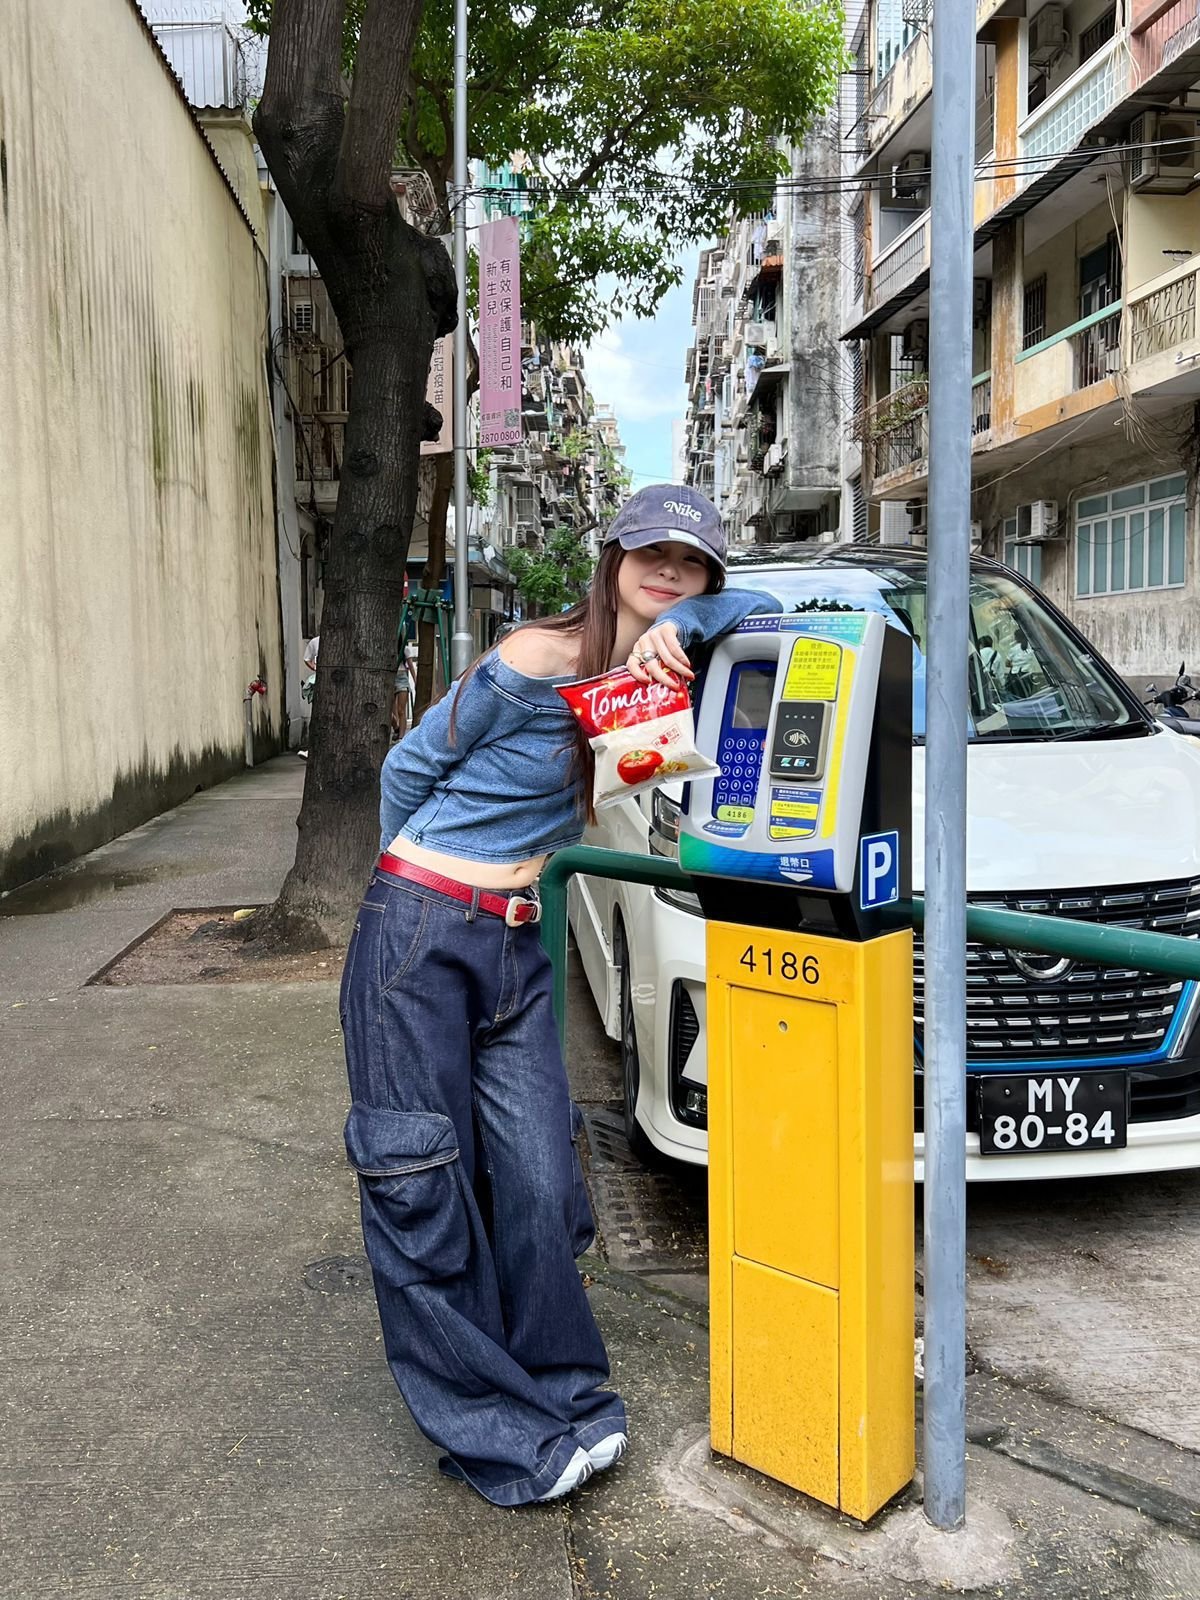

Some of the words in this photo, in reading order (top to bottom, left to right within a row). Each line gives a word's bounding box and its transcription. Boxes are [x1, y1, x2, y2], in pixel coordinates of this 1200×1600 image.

[487, 261, 498, 317] 新生兒
[500, 260, 512, 390] 有效保護自己和
[481, 432, 500, 444] 2870
[500, 430, 520, 441] 0800
[663, 500, 703, 523] Nike
[727, 810, 747, 819] 4186
[780, 856, 810, 868] 退幣口
[868, 841, 892, 901] P
[740, 945, 820, 985] 4186
[1028, 1077, 1080, 1112] MY
[993, 1110, 1115, 1150] 80-84
